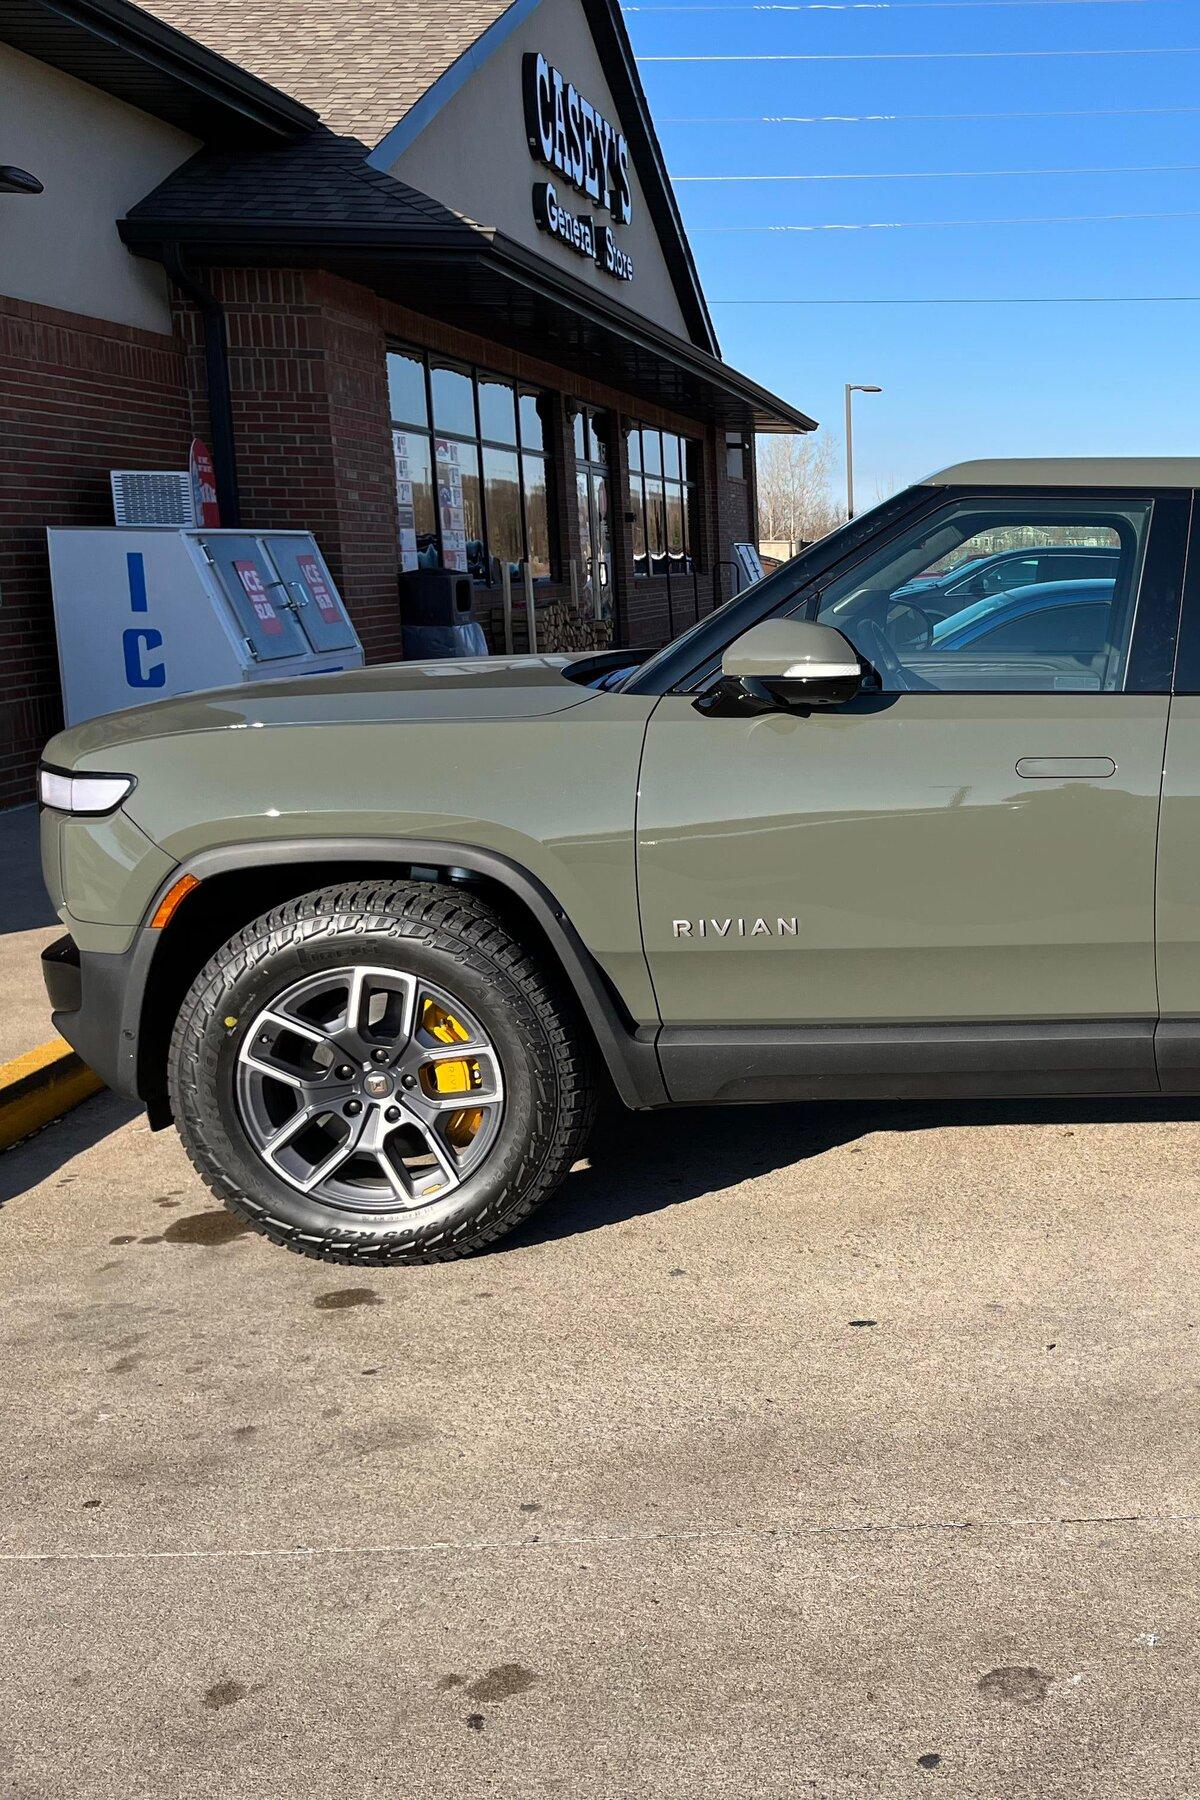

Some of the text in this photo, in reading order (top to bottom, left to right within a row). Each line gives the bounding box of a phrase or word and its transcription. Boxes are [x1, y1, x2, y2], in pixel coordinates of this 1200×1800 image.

[533, 52, 633, 226] CASEY'S
[545, 182, 634, 282] General Store
[238, 570, 264, 592] ICE
[301, 564, 323, 585] ICE
[122, 552, 167, 694] IC
[672, 917, 800, 938] RIVIAN
